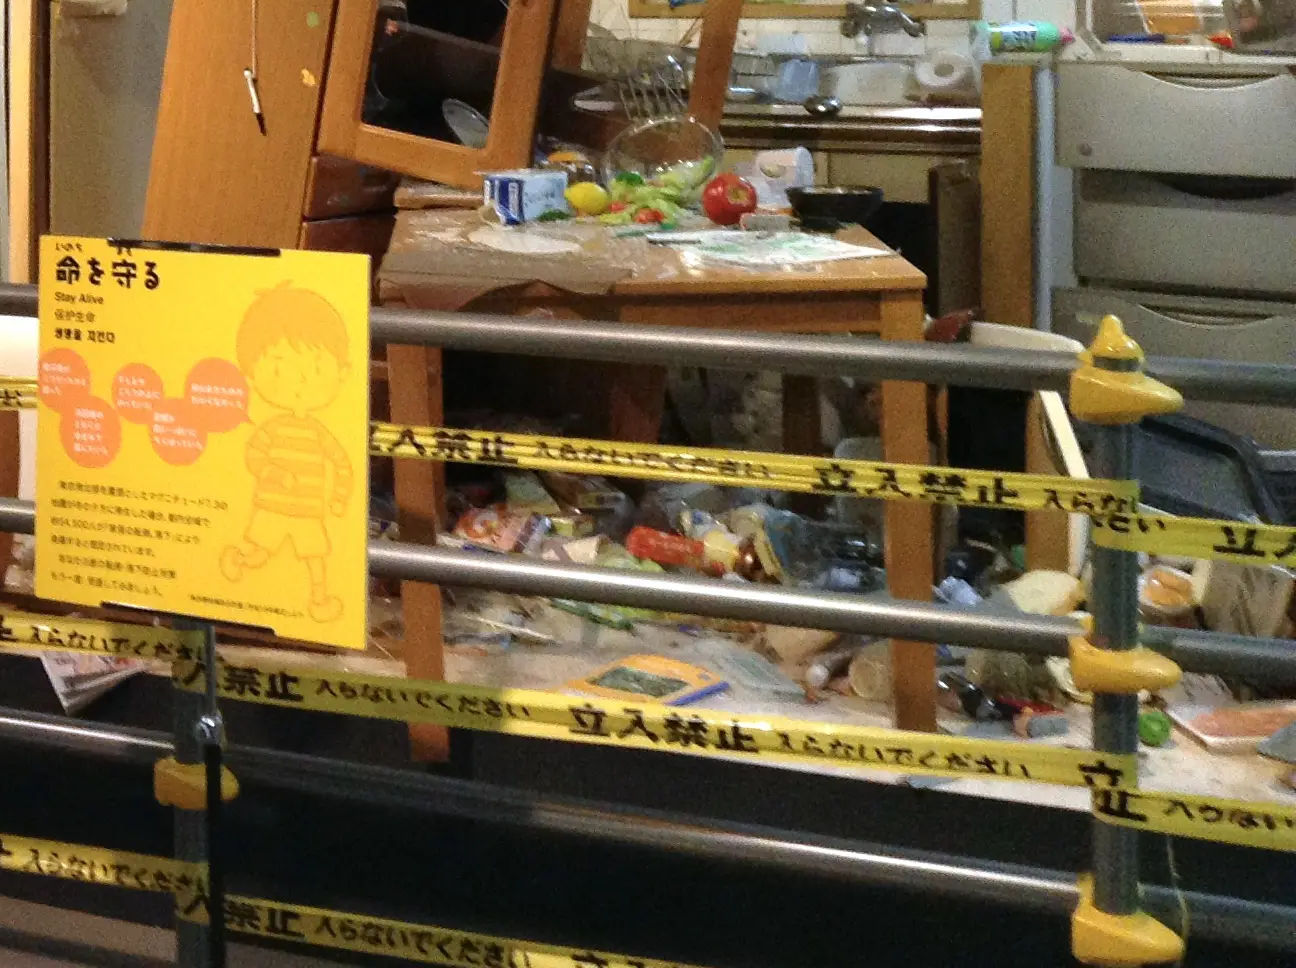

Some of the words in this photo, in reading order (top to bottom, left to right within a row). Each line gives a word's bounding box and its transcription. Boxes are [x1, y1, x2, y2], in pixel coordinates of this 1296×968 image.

[54, 291, 76, 304] Stay
[78, 293, 104, 305] Alive
[55, 254, 160, 290] 命を守る
[370, 428, 519, 465] 入禁止
[812, 462, 1019, 505] 立入禁止
[314, 678, 533, 720] 入らないでください
[569, 703, 759, 754] 立入禁止
[776, 730, 1032, 781] 入らないでください
